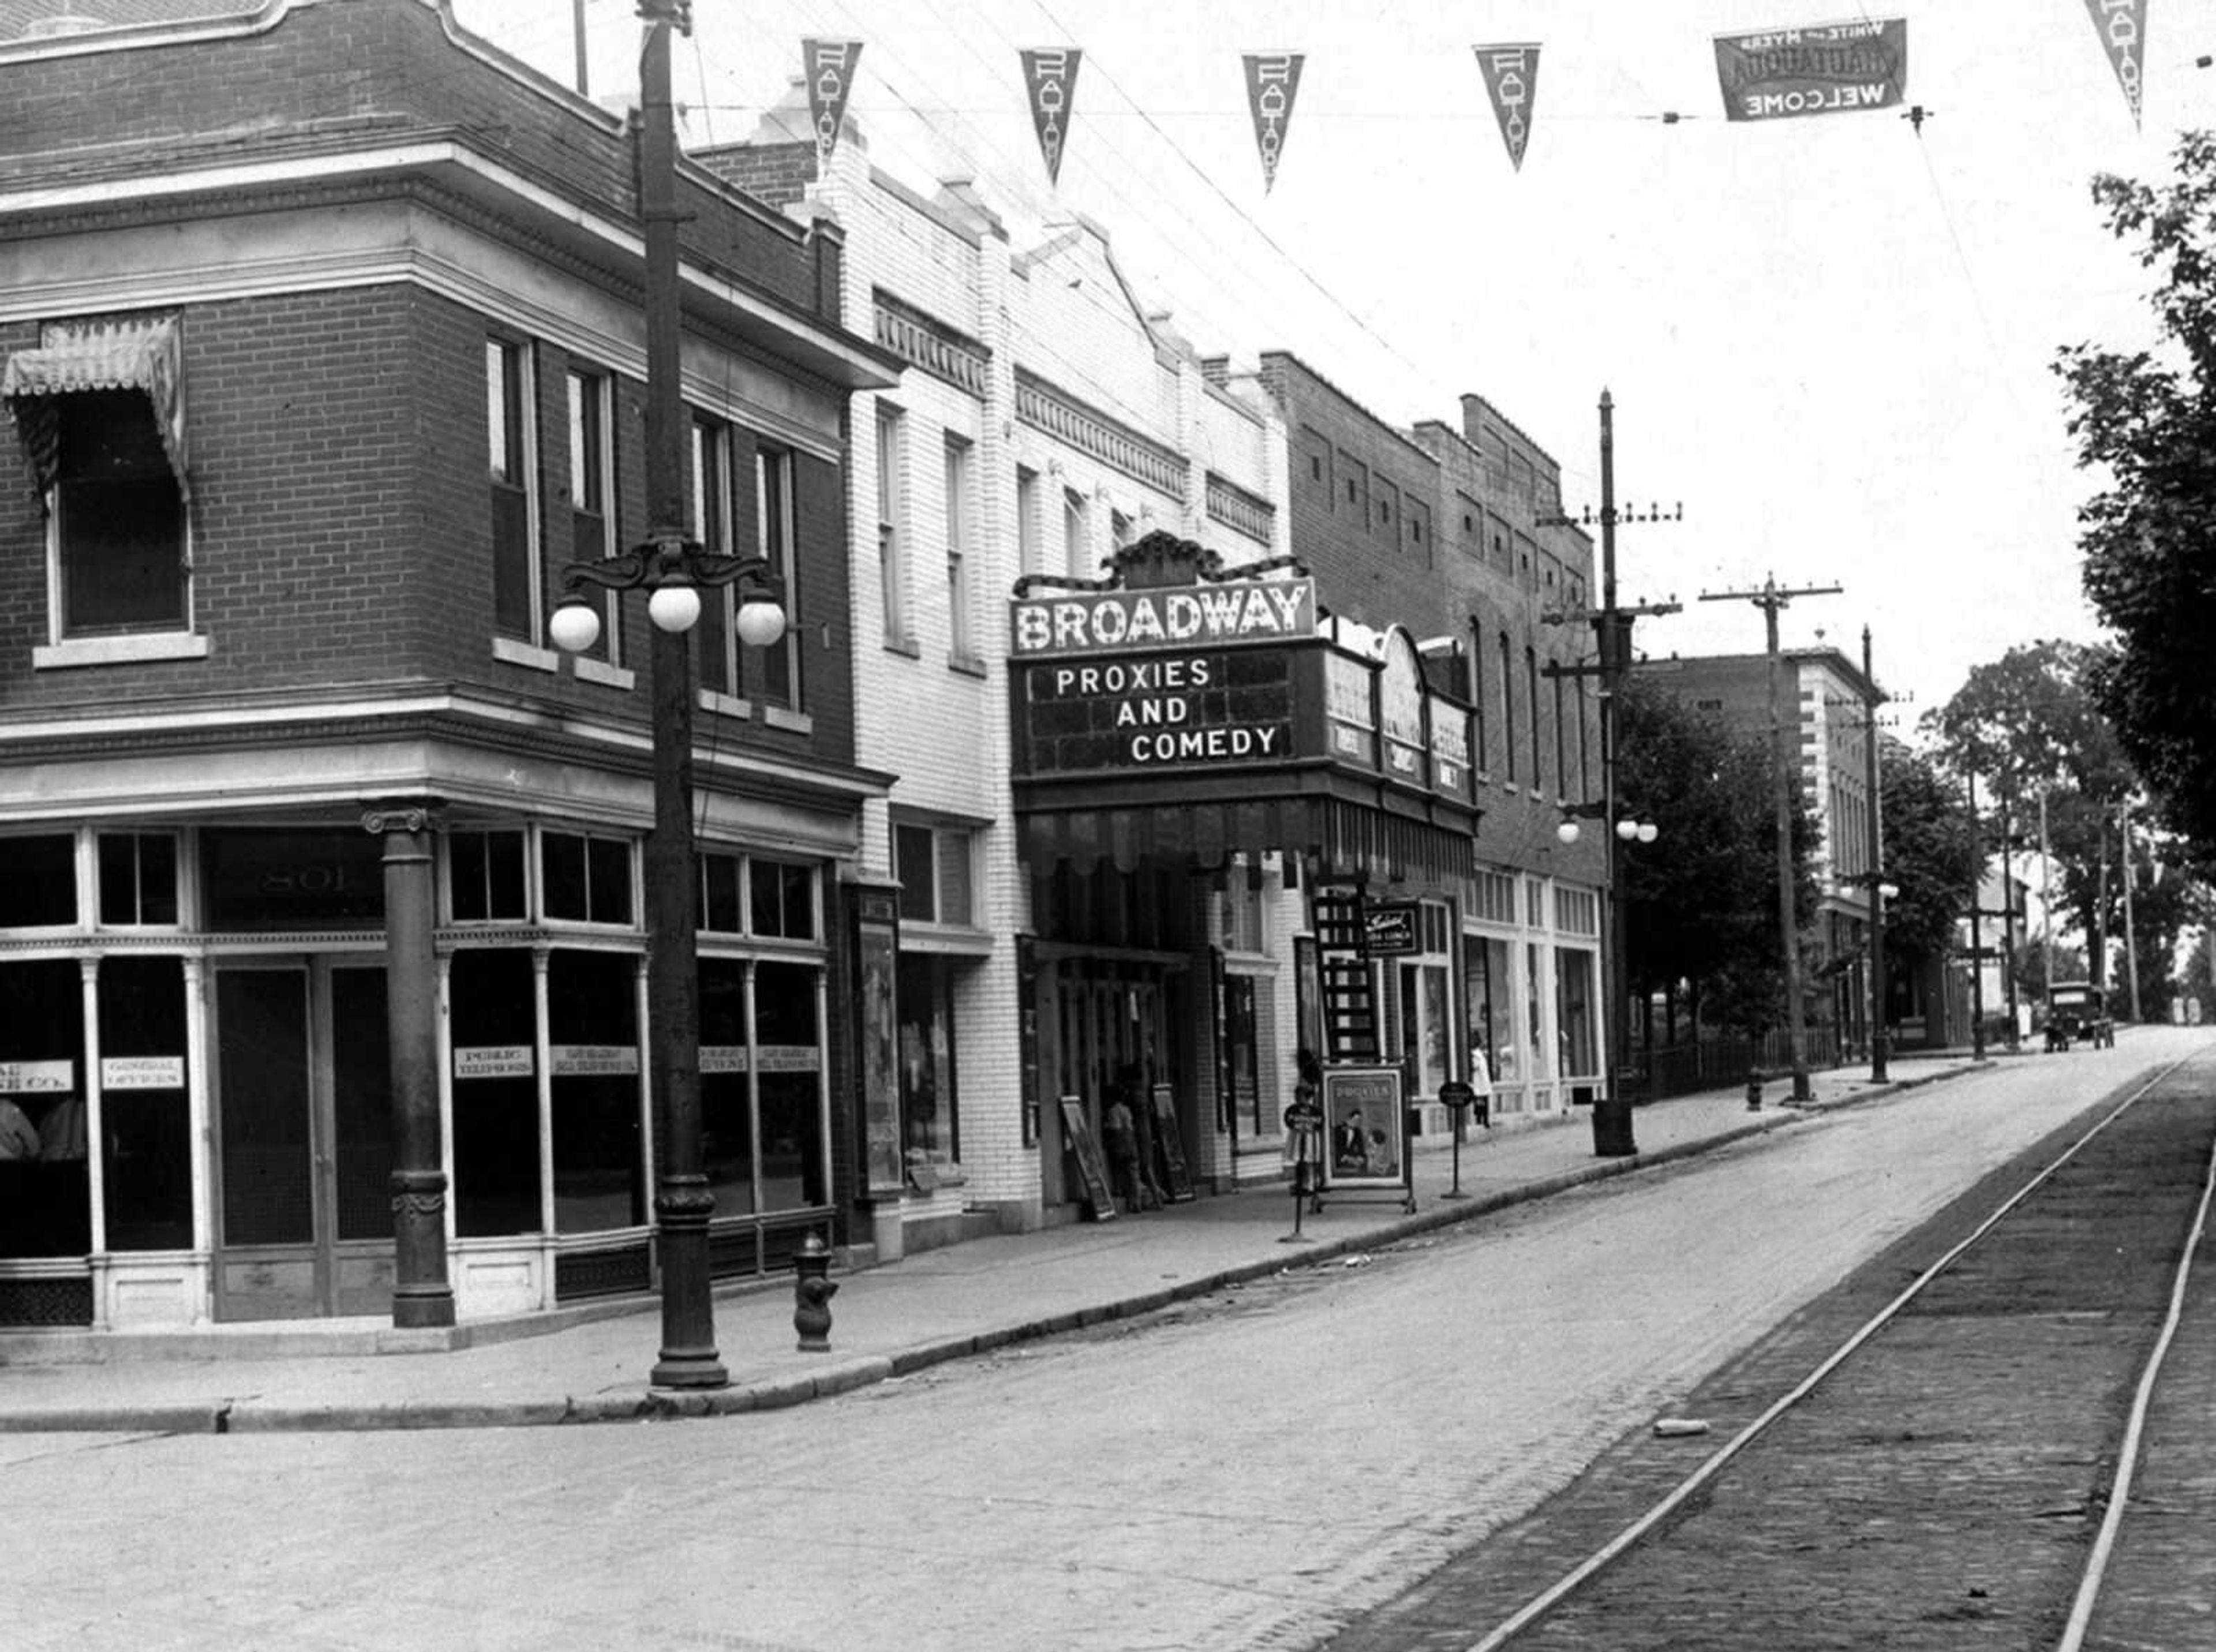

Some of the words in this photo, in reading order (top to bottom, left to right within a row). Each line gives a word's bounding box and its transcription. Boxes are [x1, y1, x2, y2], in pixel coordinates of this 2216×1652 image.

[1017, 585, 1309, 651] BROADWAY
[1057, 659, 1210, 696] PROXIES
[1117, 697, 1188, 728] AND
[1132, 726, 1277, 762] COMEDY
